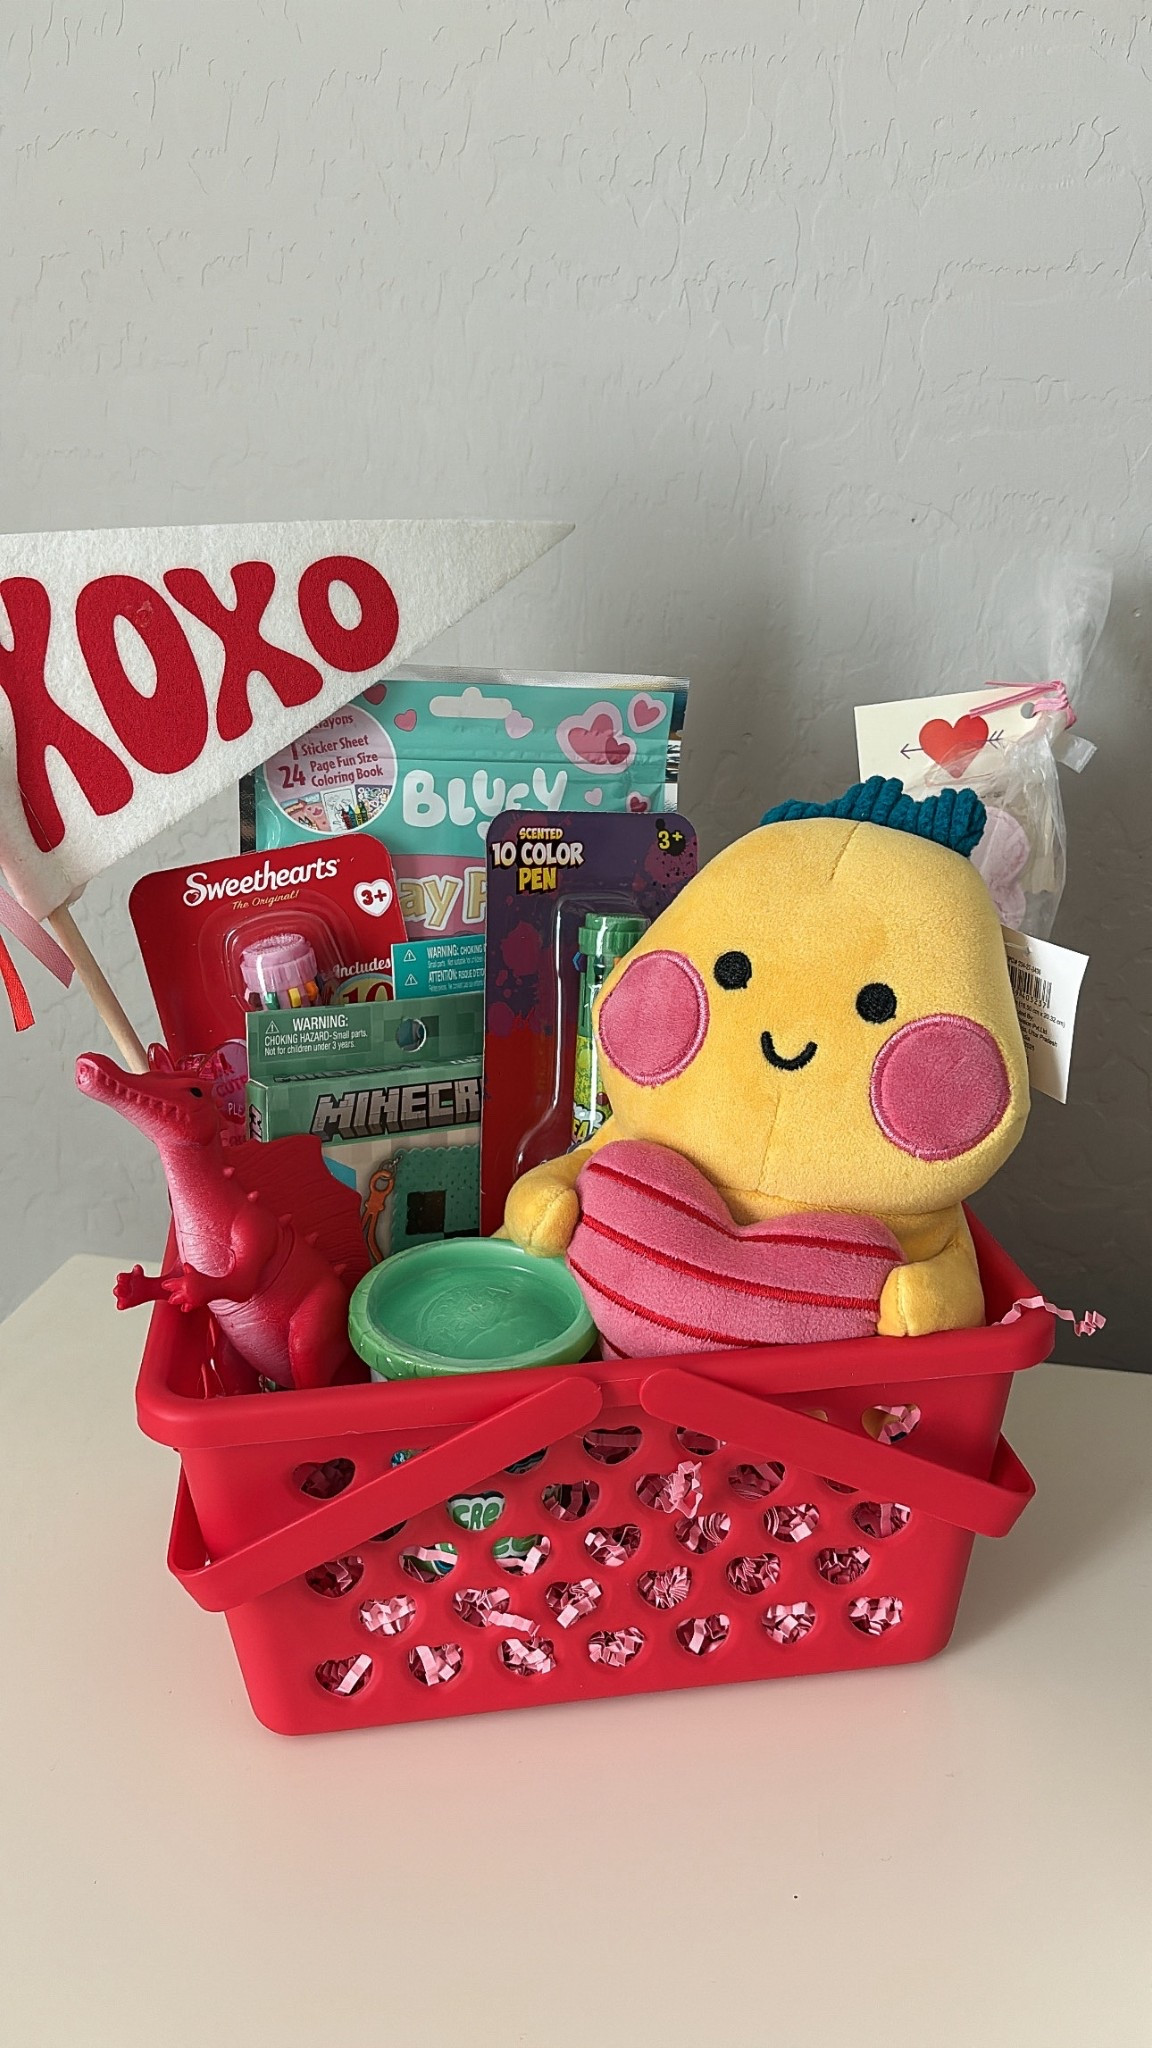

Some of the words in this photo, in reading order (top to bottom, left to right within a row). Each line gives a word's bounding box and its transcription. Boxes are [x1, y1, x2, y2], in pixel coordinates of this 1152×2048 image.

[0, 556, 399, 853] XOXO
[314, 715, 354, 730] rayons
[301, 741, 338, 757] Sticker
[339, 735, 369, 750] Sheet
[278, 764, 306, 789] 24
[310, 760, 336, 773] Page
[336, 756, 356, 768] Fun
[357, 752, 379, 764] Size
[311, 772, 355, 787] Coloring
[356, 765, 384, 780] Book
[519, 828, 563, 840] SCENTED
[657, 830, 683, 850] 3+
[491, 842, 517, 867] 10
[521, 841, 585, 866] COLOR
[183, 857, 338, 907] Sweethearts
[518, 867, 557, 892] PEN
[232, 901, 249, 911] The
[251, 889, 300, 908] Original!
[361, 889, 387, 906] 3+
[427, 944, 459, 959] WARNING:
[460, 945, 482, 955] CHOKING
[333, 957, 392, 978] Includes
[429, 969, 458, 983] ATTENTION:
[292, 1014, 349, 1032] WARNING:
[264, 1033, 298, 1047] CHOKING
[351, 1029, 368, 1040] parts.
[264, 1046, 277, 1056] Not
[277, 1046, 286, 1055] for
[287, 1043, 312, 1054] children
[313, 1042, 331, 1052] under
[332, 1041, 337, 1050] 3
[337, 1040, 356, 1051] years.
[310, 1076, 484, 1142] MINECR
